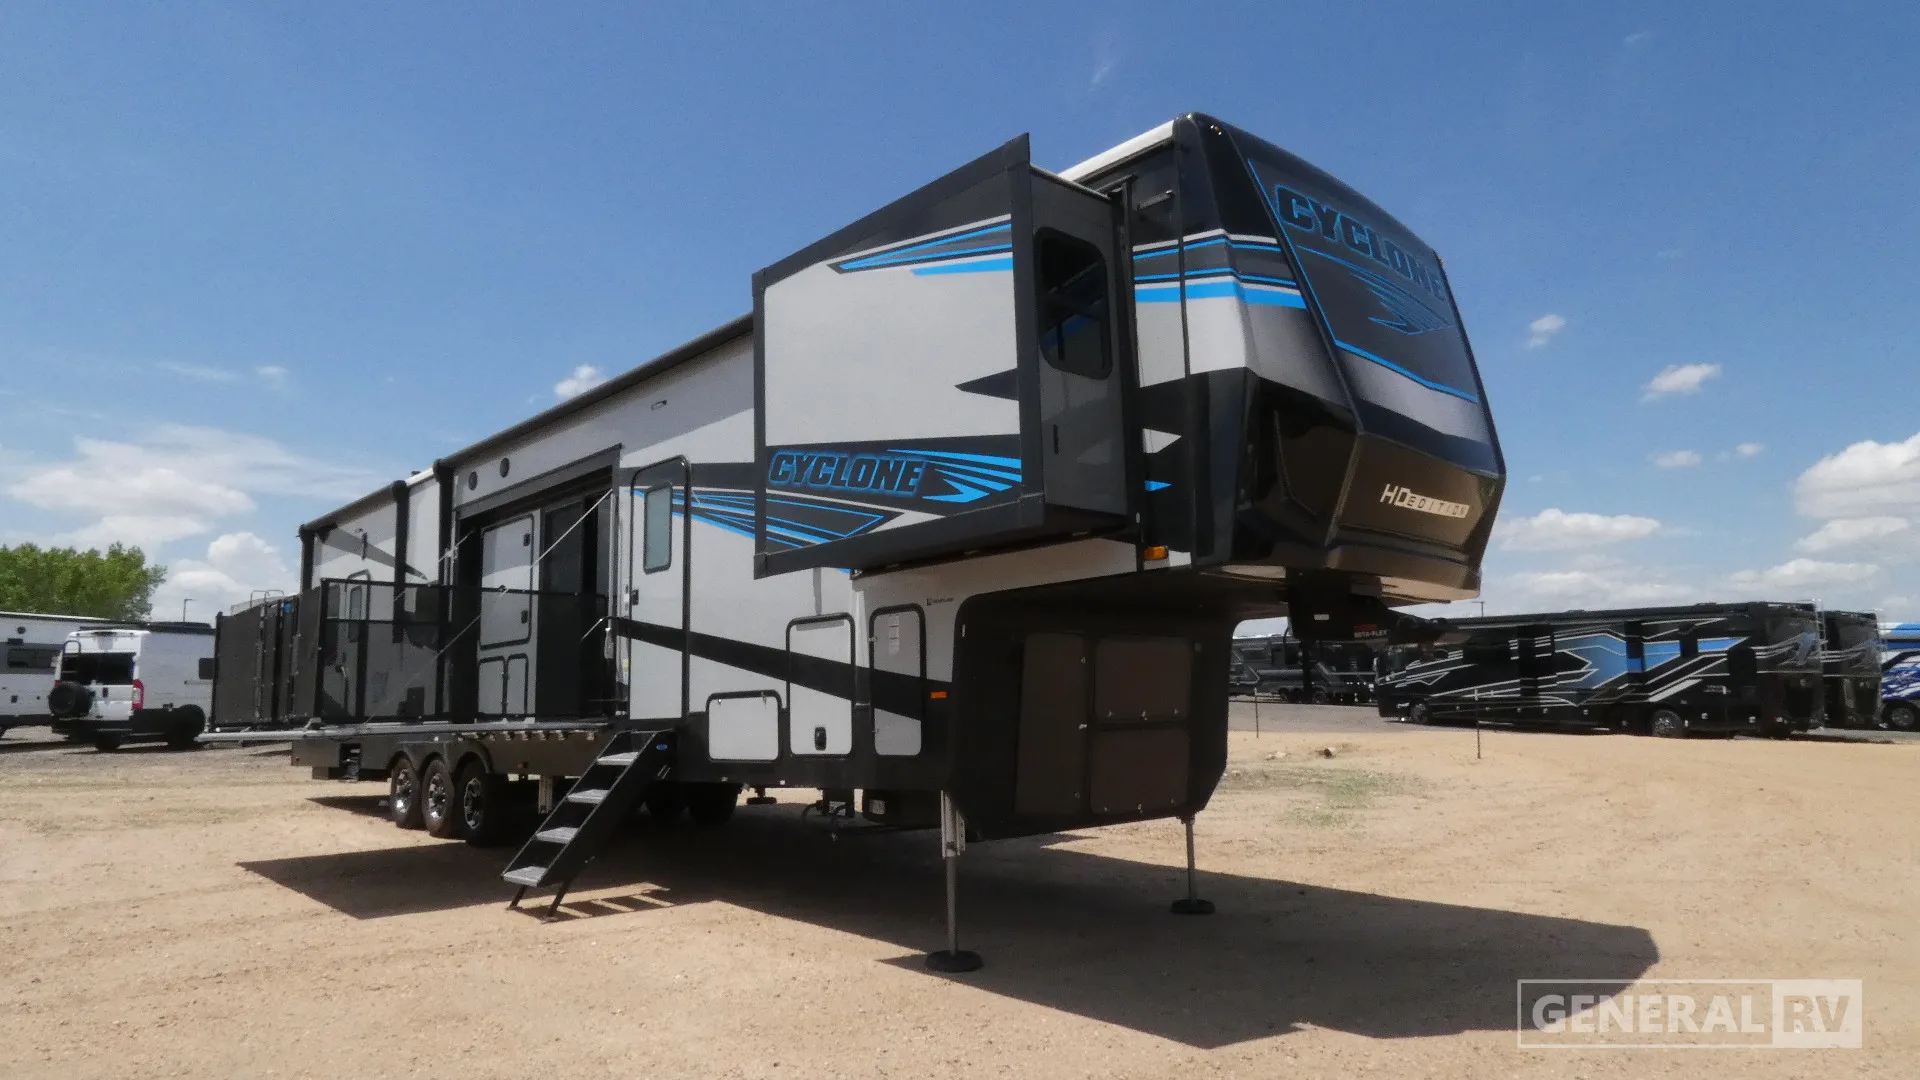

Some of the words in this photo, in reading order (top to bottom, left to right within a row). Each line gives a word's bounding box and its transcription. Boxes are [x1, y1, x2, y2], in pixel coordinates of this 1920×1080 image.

[1274, 184, 1447, 303] CYCLONE
[769, 451, 926, 496] CYCLONE
[1380, 484, 1411, 506] HD
[1406, 495, 1466, 516] EDITION
